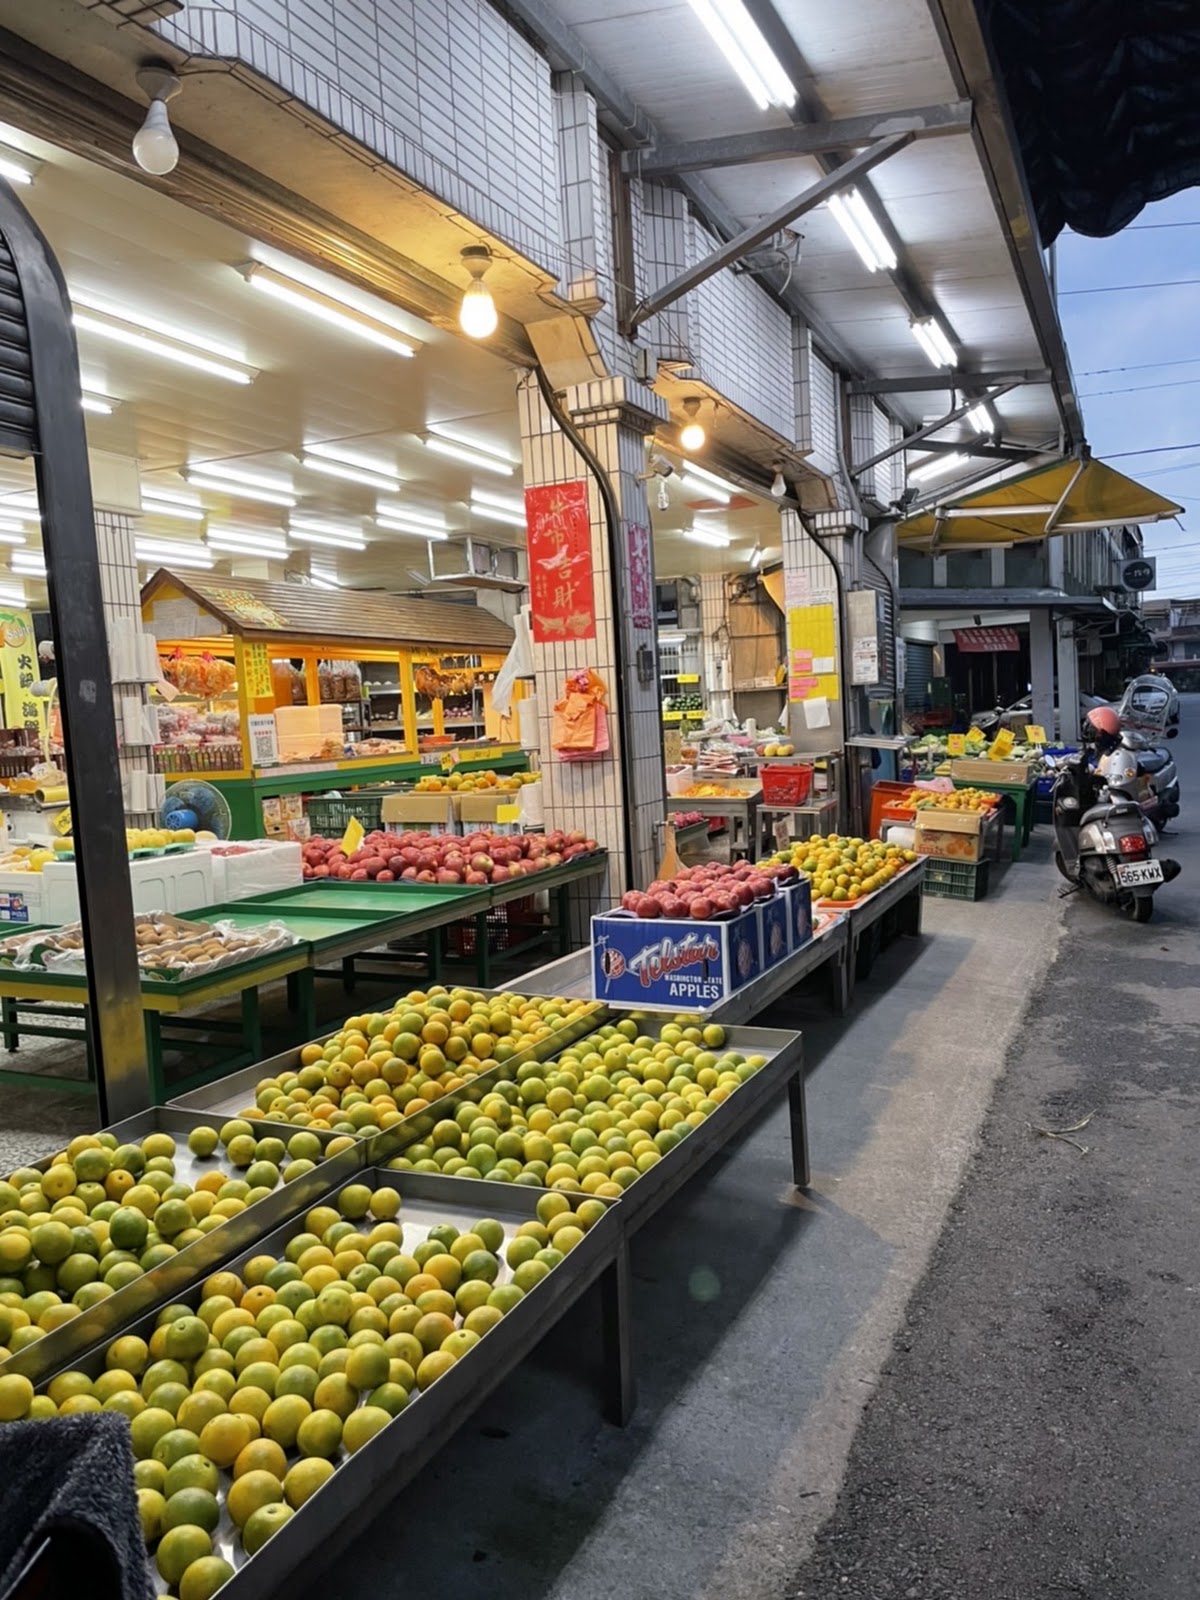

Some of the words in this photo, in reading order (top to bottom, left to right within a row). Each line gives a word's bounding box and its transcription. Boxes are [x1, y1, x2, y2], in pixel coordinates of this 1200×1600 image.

[629, 933, 720, 987] Telstar
[703, 975, 723, 985] TATE
[669, 983, 719, 999] APPLES
